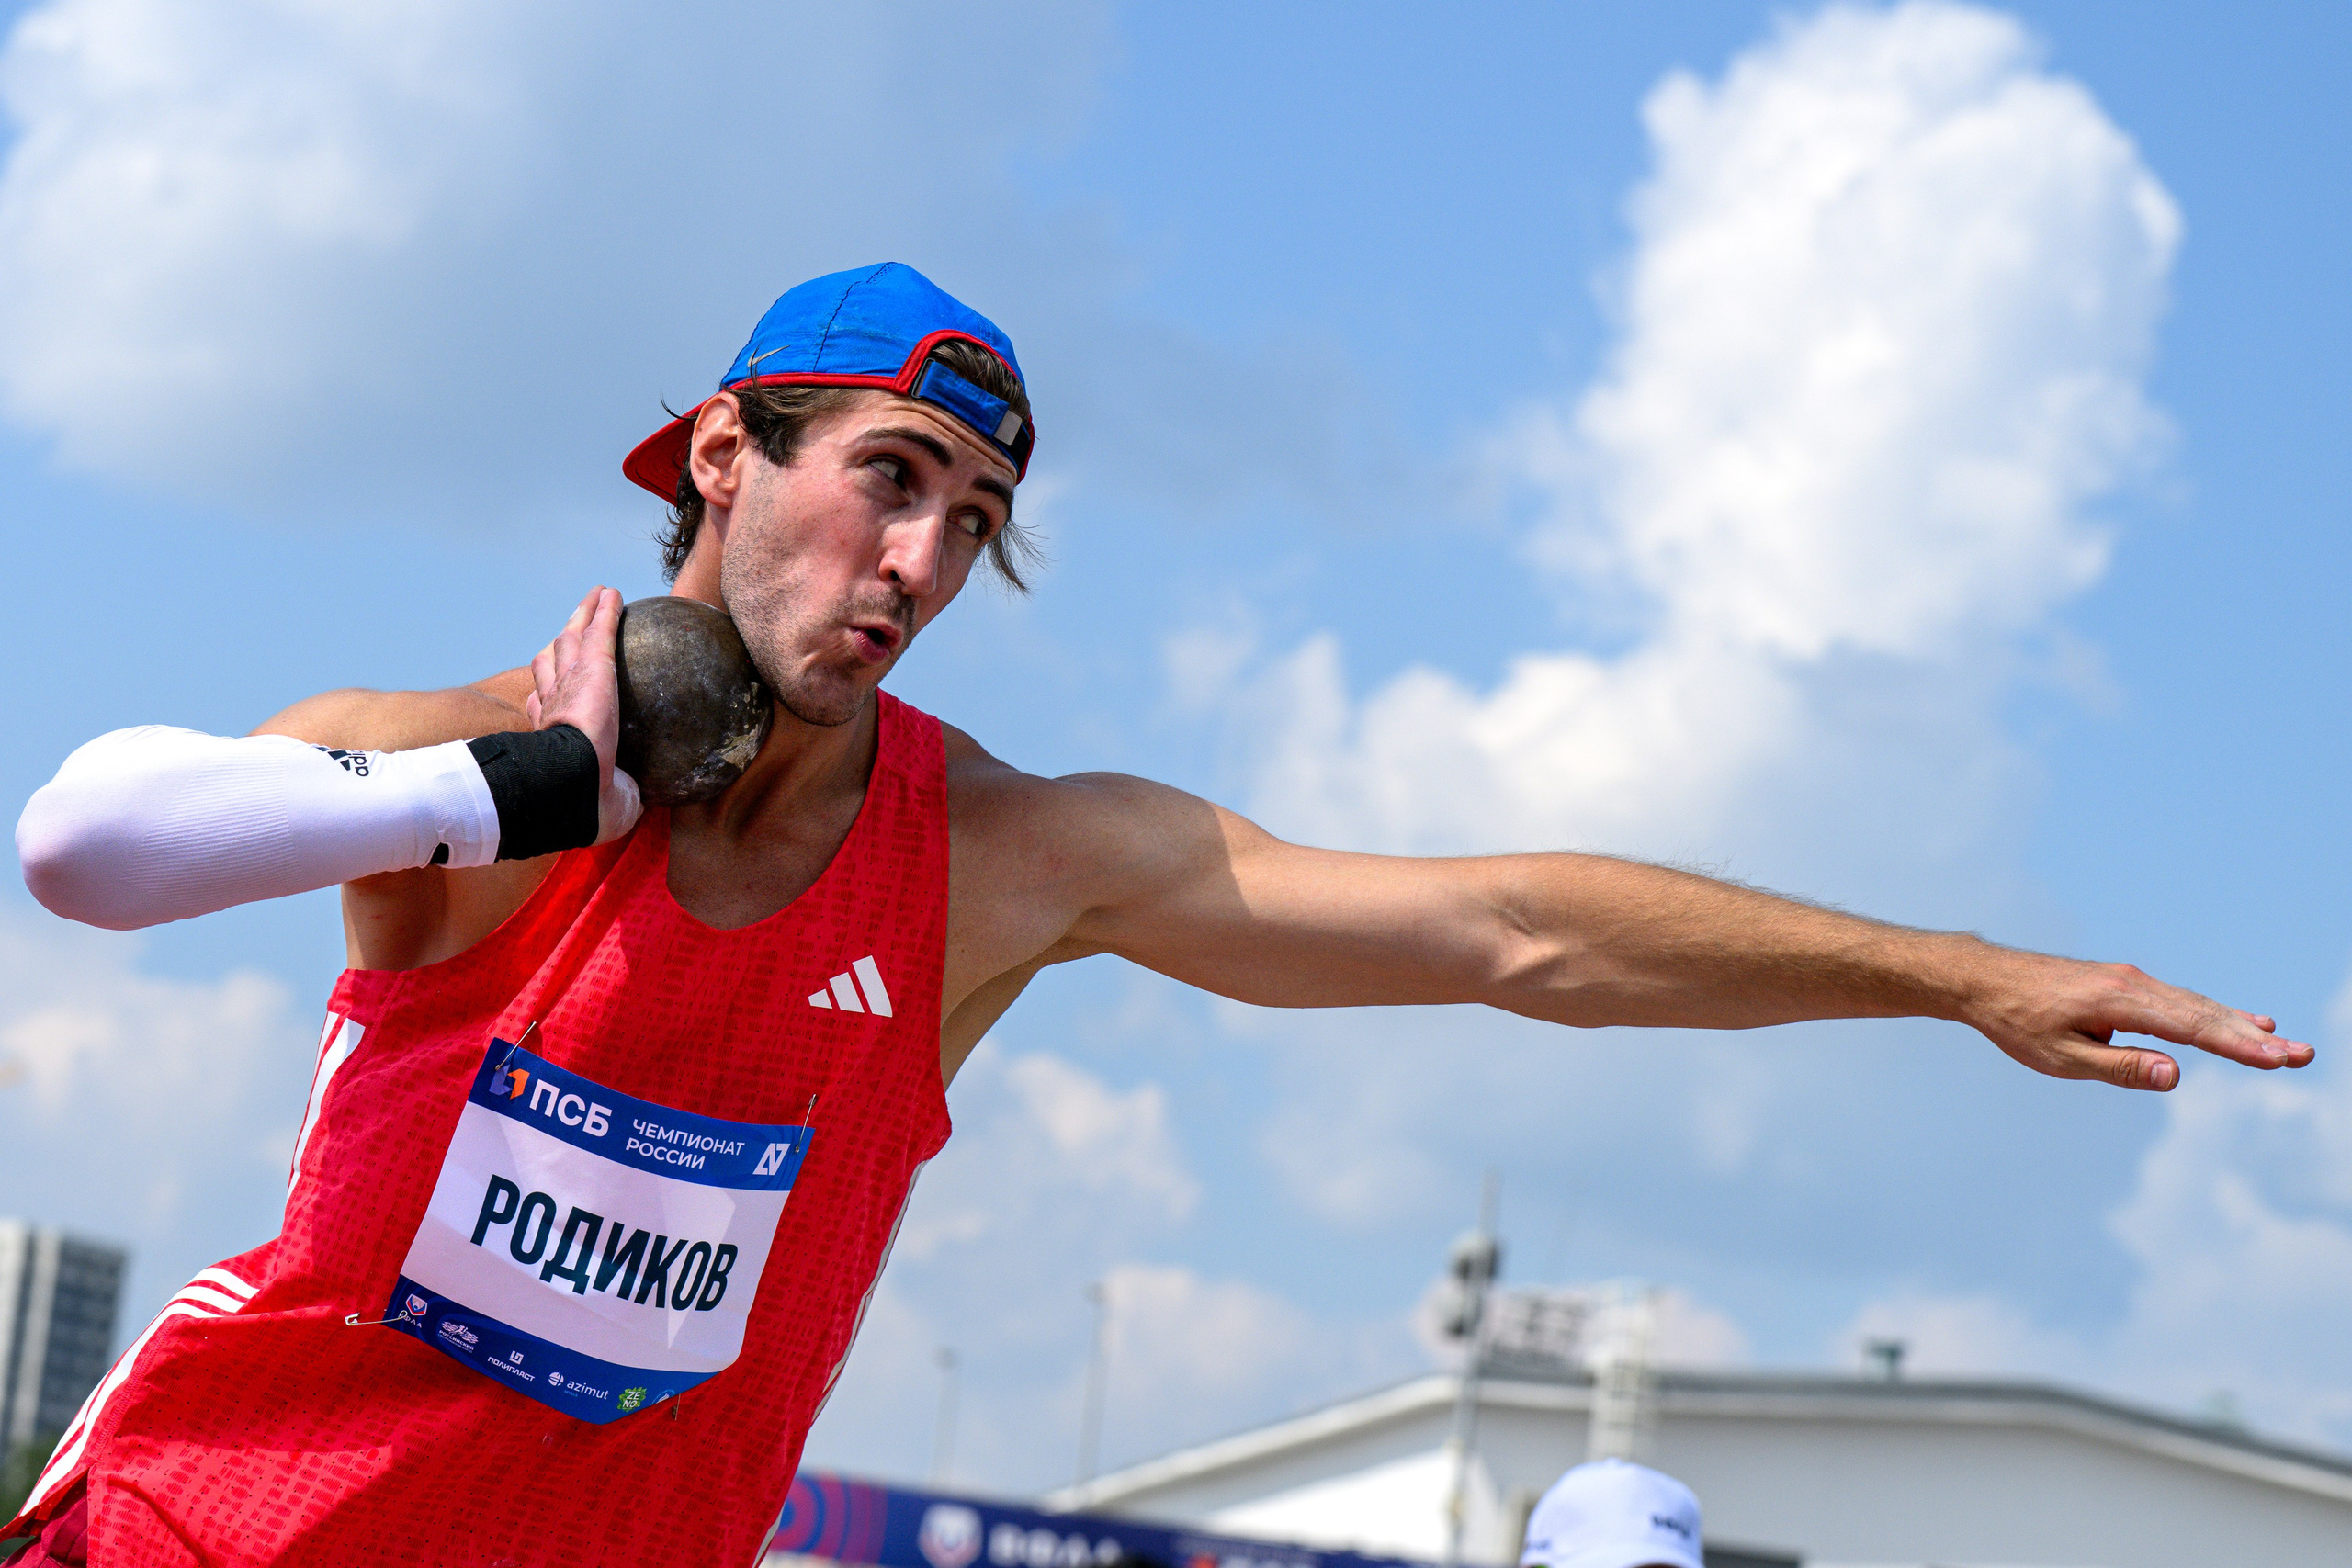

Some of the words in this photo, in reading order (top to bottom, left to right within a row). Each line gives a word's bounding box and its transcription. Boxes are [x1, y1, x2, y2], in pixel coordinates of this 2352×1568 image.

[529, 1078, 613, 1137] ПСБ
[626, 1137, 706, 1170] РОССИИ
[633, 1119, 745, 1156] ЧЕМПИОНАТ
[470, 1174, 739, 1312] РОДИКОВ
[398, 1311, 423, 1329] ФЛА
[487, 1356, 536, 1382] ПОЛИПЛАСТ
[566, 1380, 609, 1399] azimut
